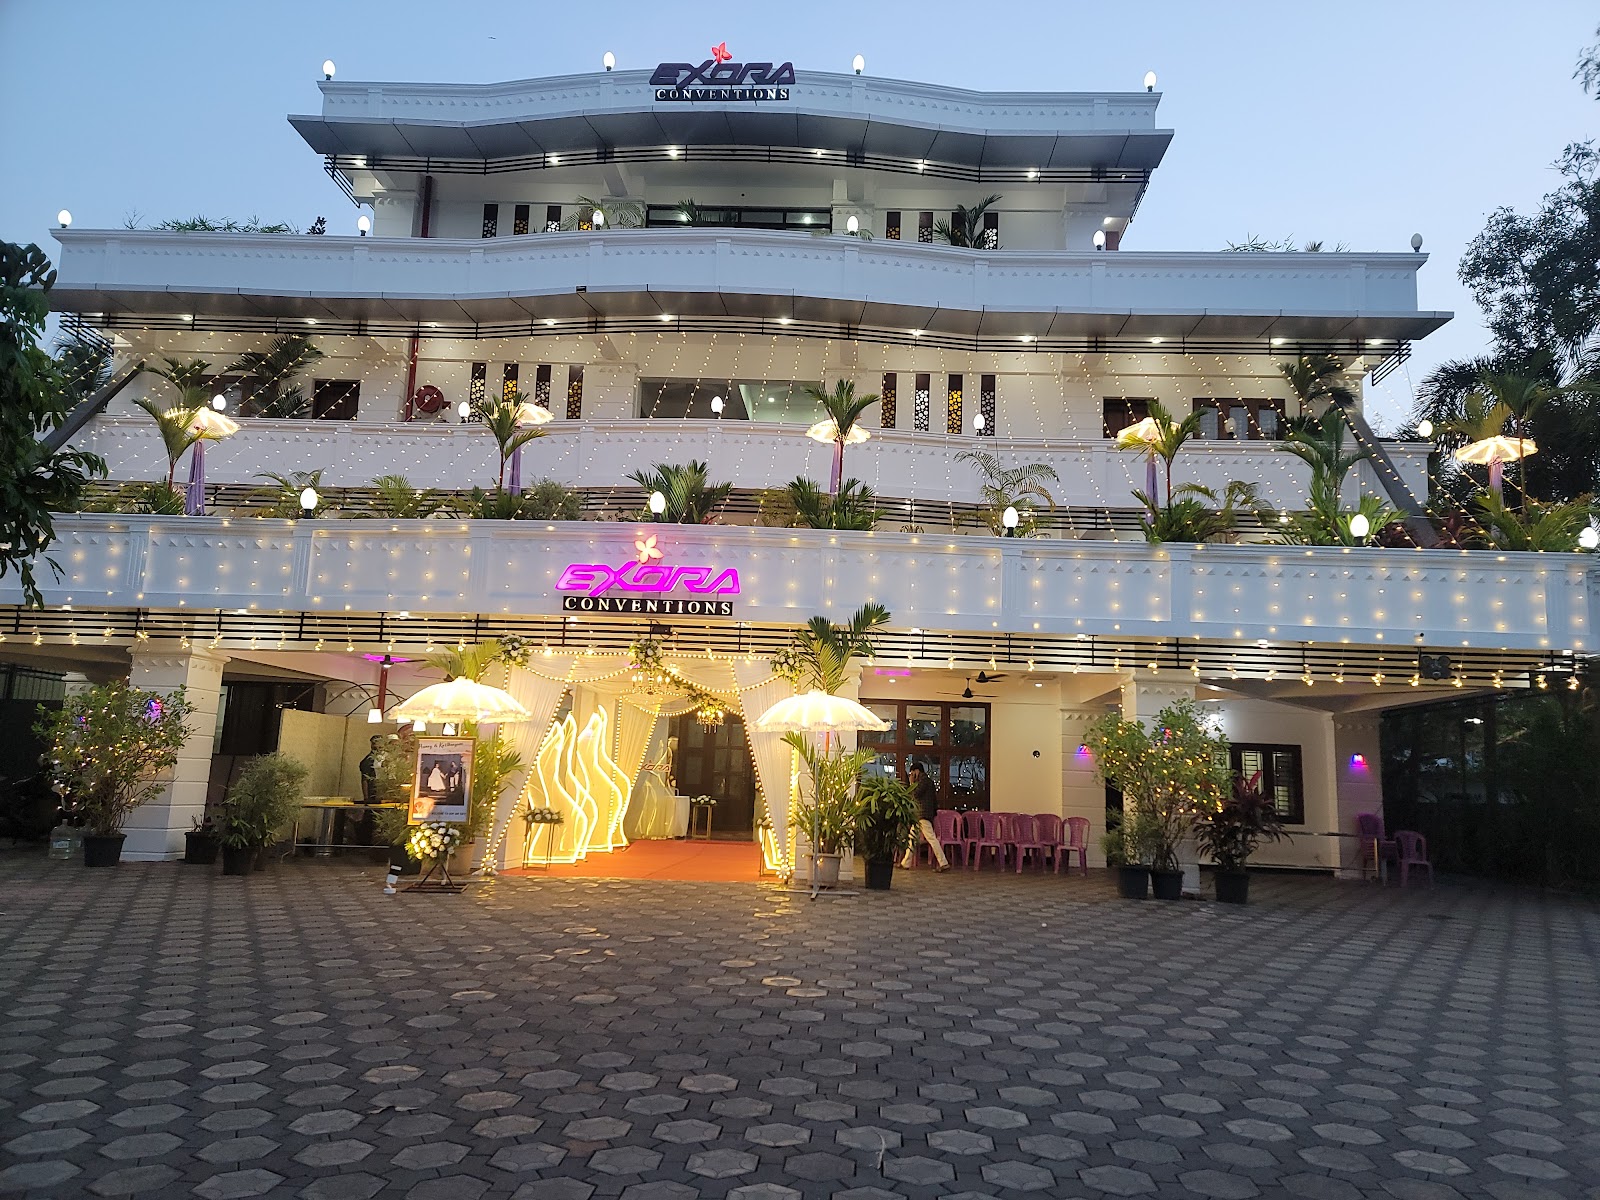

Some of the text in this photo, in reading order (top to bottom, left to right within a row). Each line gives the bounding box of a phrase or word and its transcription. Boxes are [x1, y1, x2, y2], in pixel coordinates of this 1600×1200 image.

[649, 60, 796, 90] EXORA
[656, 89, 788, 100] CONVENTIONS
[555, 561, 741, 597] EXORA
[564, 597, 731, 615] CONVENTIONS
